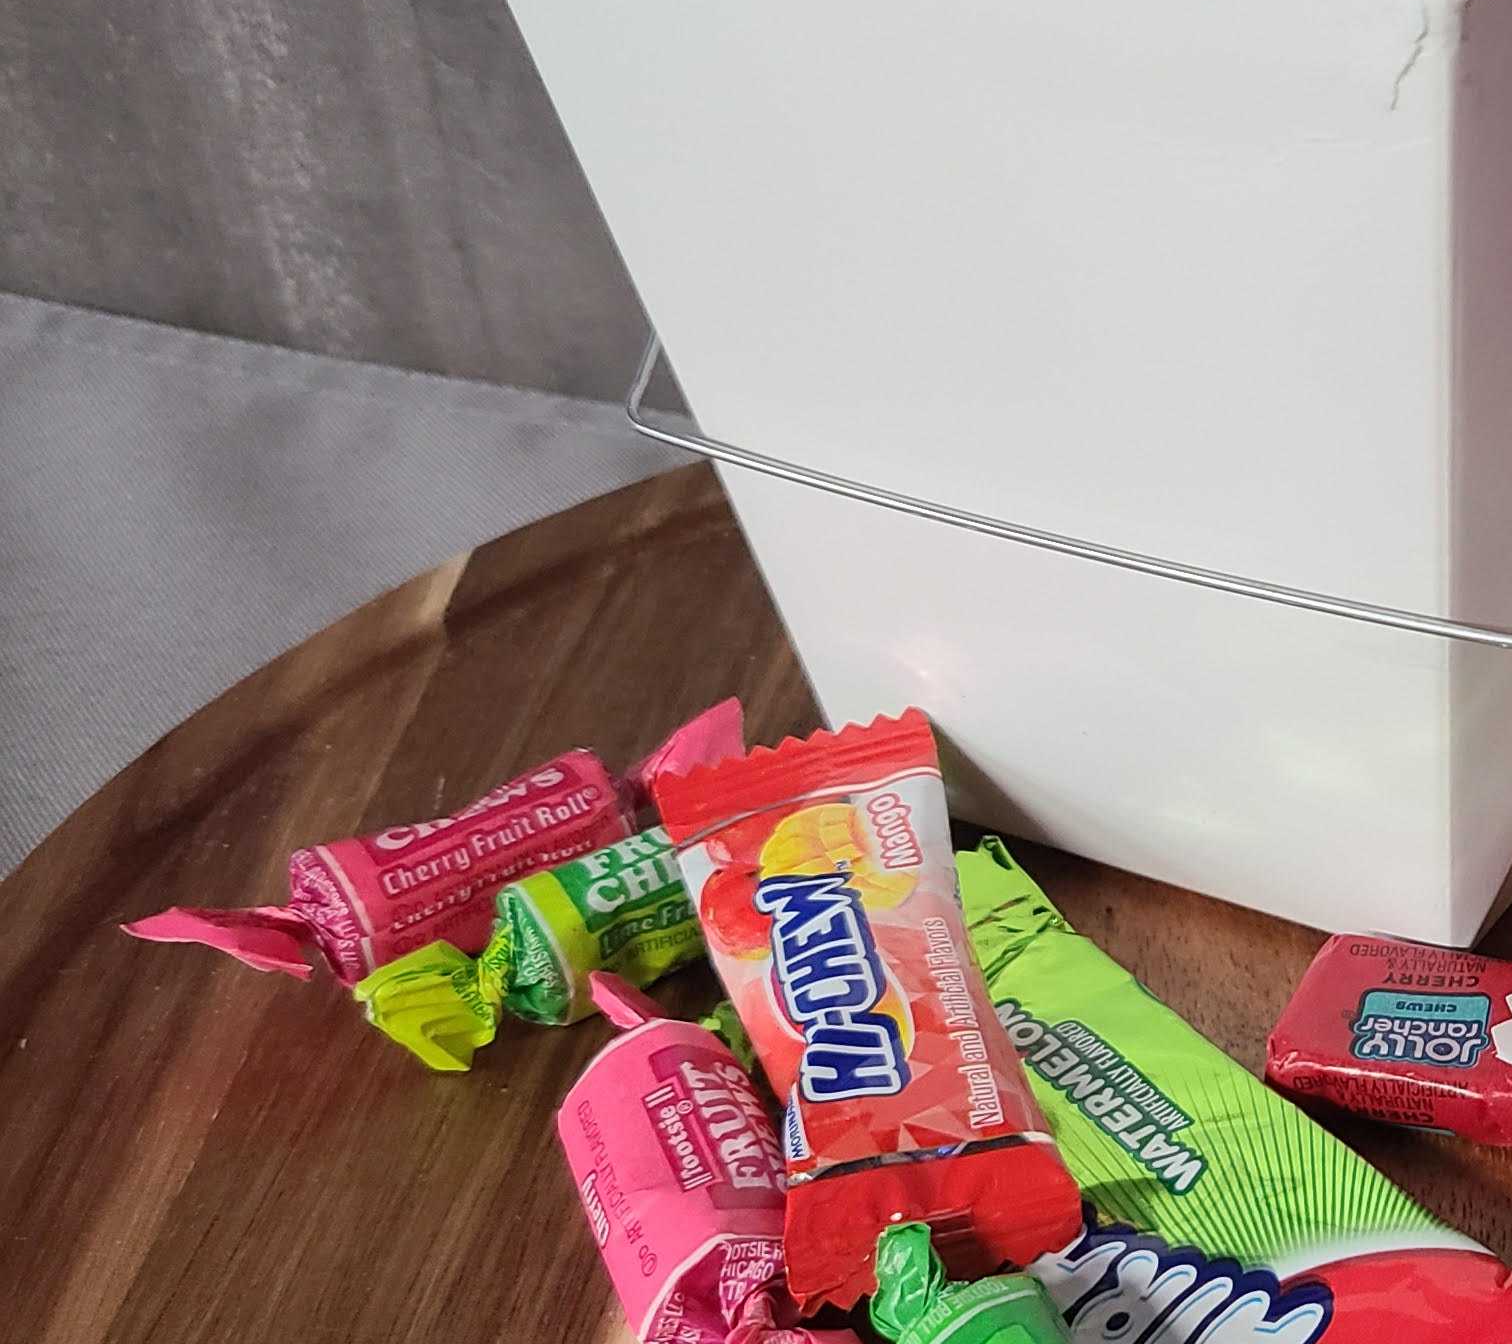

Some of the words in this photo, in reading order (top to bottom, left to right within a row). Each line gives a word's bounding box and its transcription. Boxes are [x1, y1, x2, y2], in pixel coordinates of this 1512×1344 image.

[382, 847, 472, 897] Cherry
[471, 815, 535, 856] Fruit
[868, 791, 921, 869] Mango
[924, 918, 957, 970] Flavors
[1399, 958, 1488, 974] NATURALLY
[754, 873, 911, 1101] HI-CHEW
[931, 970, 977, 1028] Artificial
[1382, 972, 1480, 988] CHERRY
[951, 1030, 987, 1064] and
[1055, 1022, 1120, 1069] FLAVORED
[1361, 1015, 1479, 1039] rancher
[1361, 1032, 1482, 1063] JOLLY
[681, 1061, 773, 1189] FRUIT
[959, 1064, 1003, 1128] Natural
[995, 1001, 1203, 1193] WATERMELON
[1106, 1061, 1190, 1131] ARTIFICIALLY
[658, 1104, 704, 1179] Tootsie
[720, 1260, 775, 1281] HICAGO
